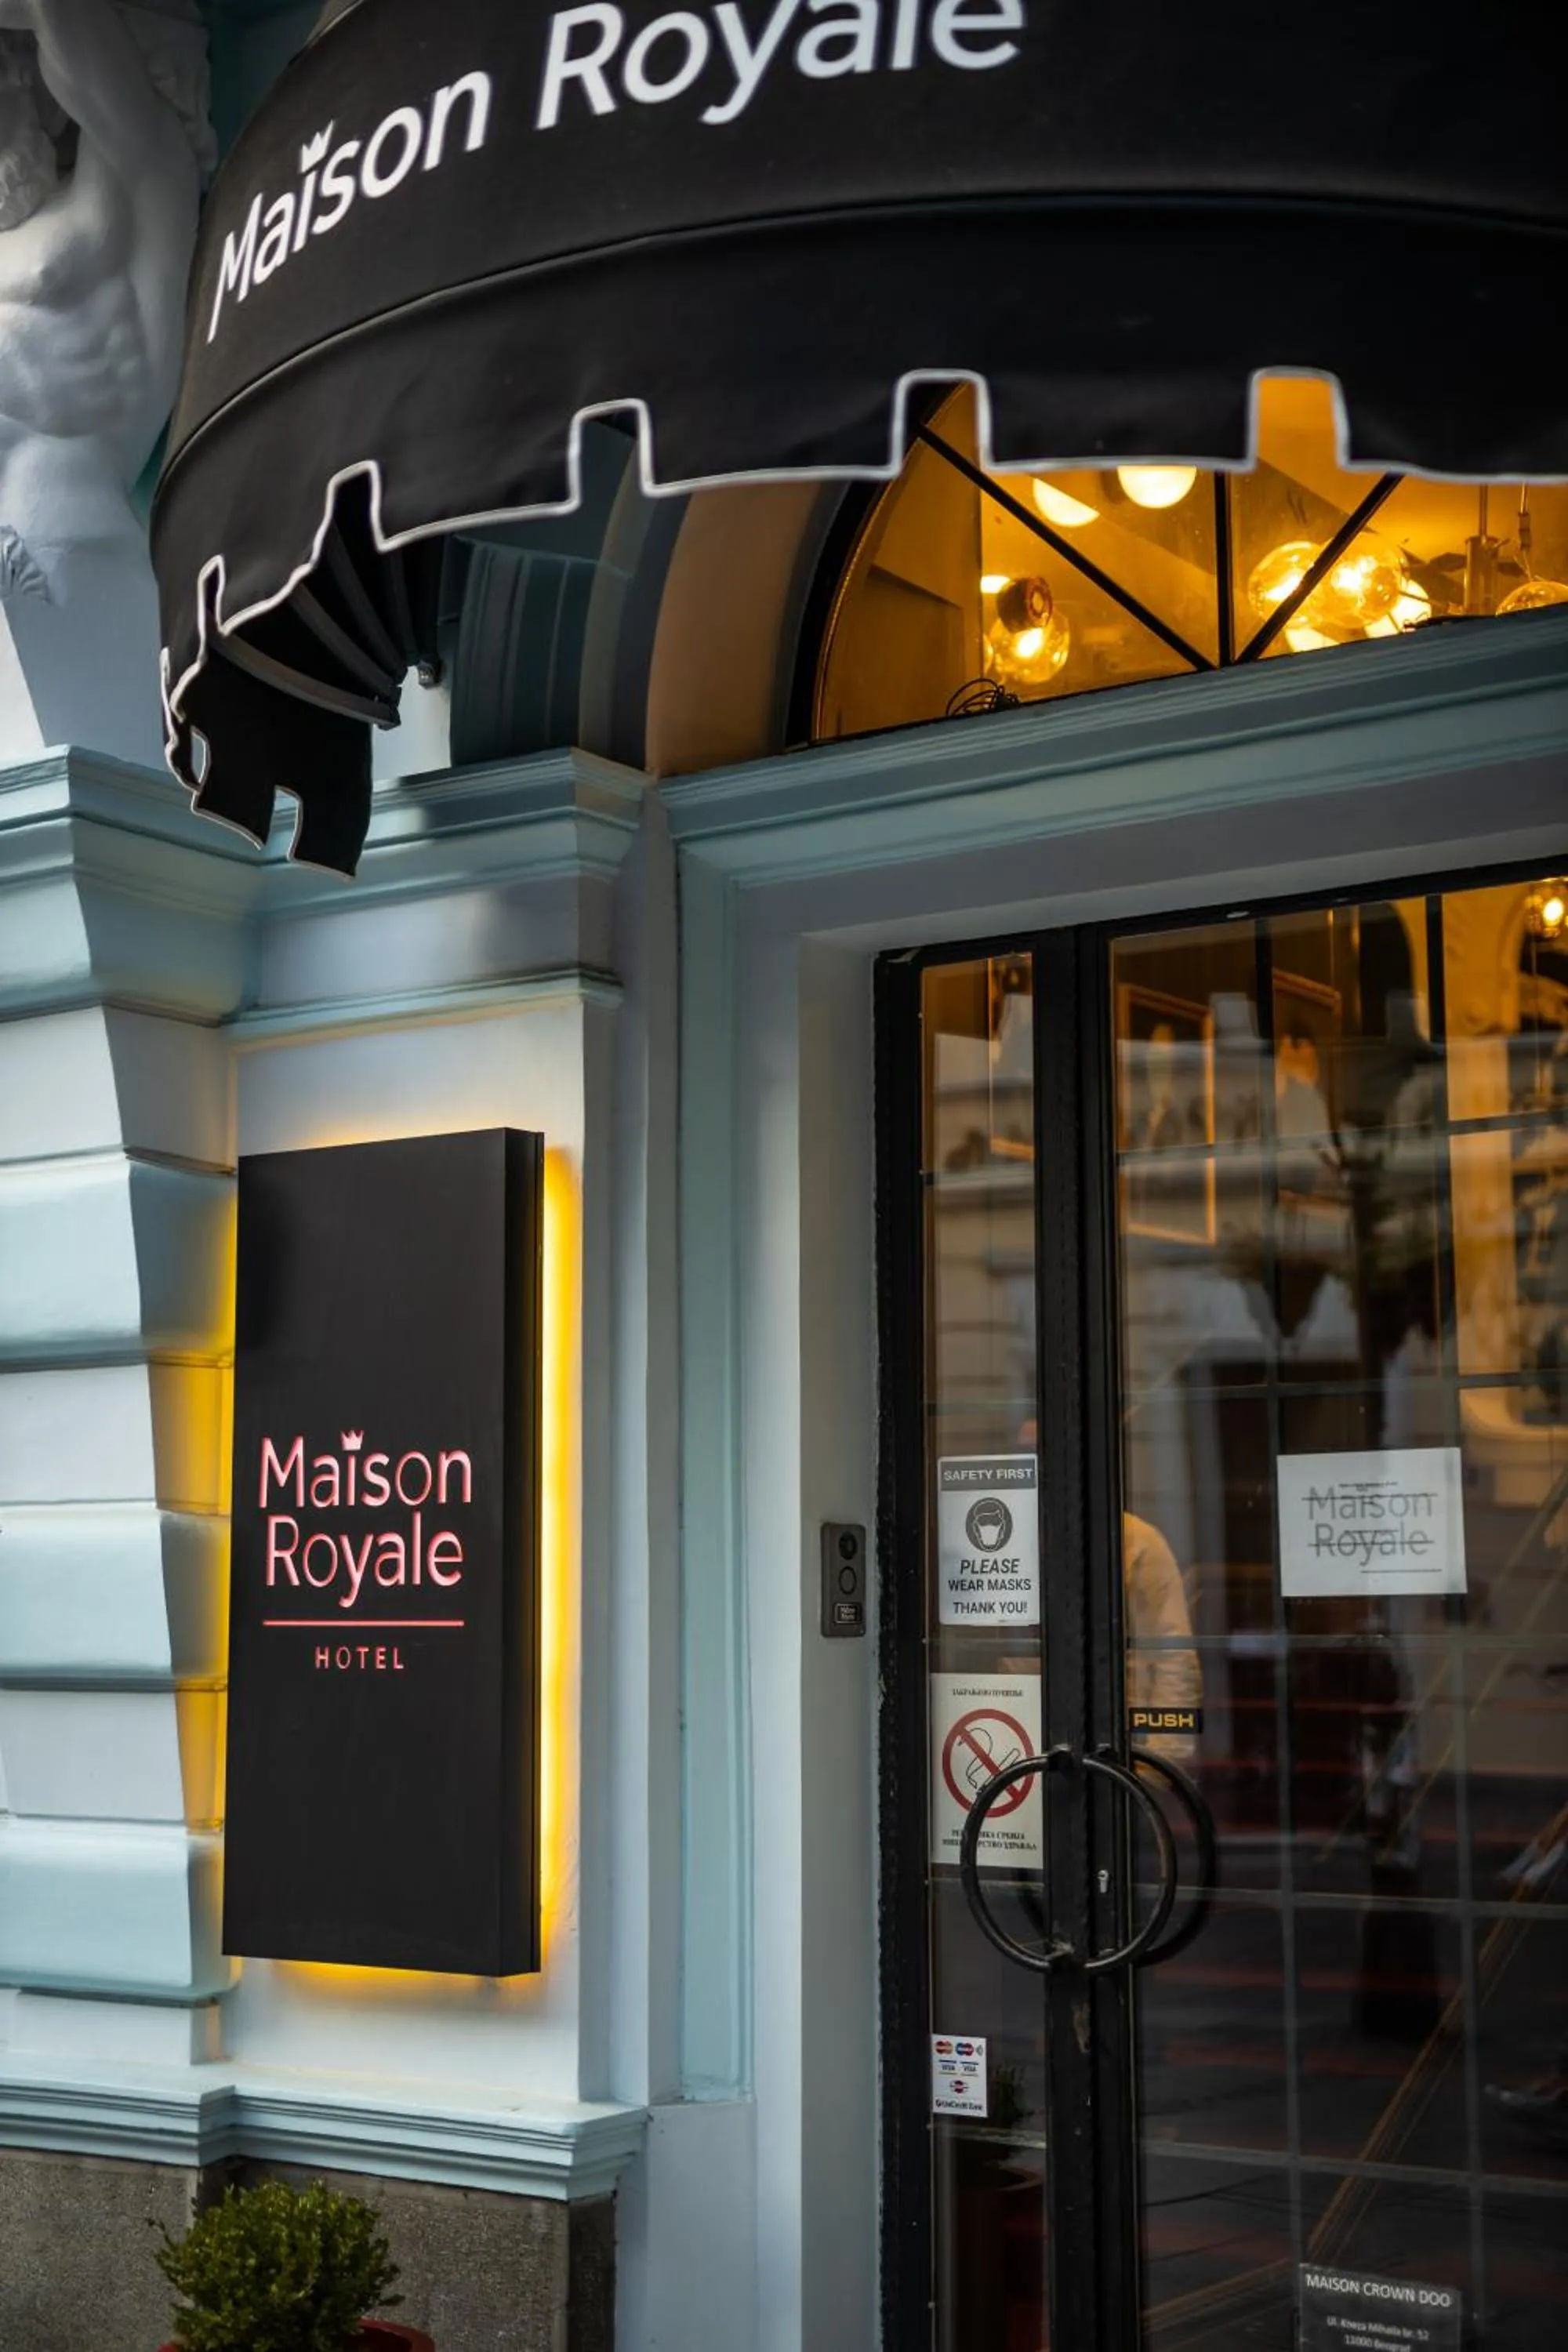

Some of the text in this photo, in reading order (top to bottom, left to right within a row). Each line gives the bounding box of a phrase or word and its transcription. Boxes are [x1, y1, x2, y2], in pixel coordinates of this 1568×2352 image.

[207, 0, 1026, 343] Maison Royale
[259, 1431, 472, 1508] Maison
[943, 1468, 1033, 1481] SAFETY FIRST
[266, 1511, 464, 1608] Royale
[960, 1558, 1021, 1574] PLEASE
[948, 1578, 1032, 1591] WEAR MASKS
[953, 1602, 1028, 1614] THANK YOU!
[315, 1646, 405, 1669] HOTEL
[1134, 1713, 1195, 1728] PUSH
[1305, 2274, 1451, 2307] MAISON CROWN DOO
